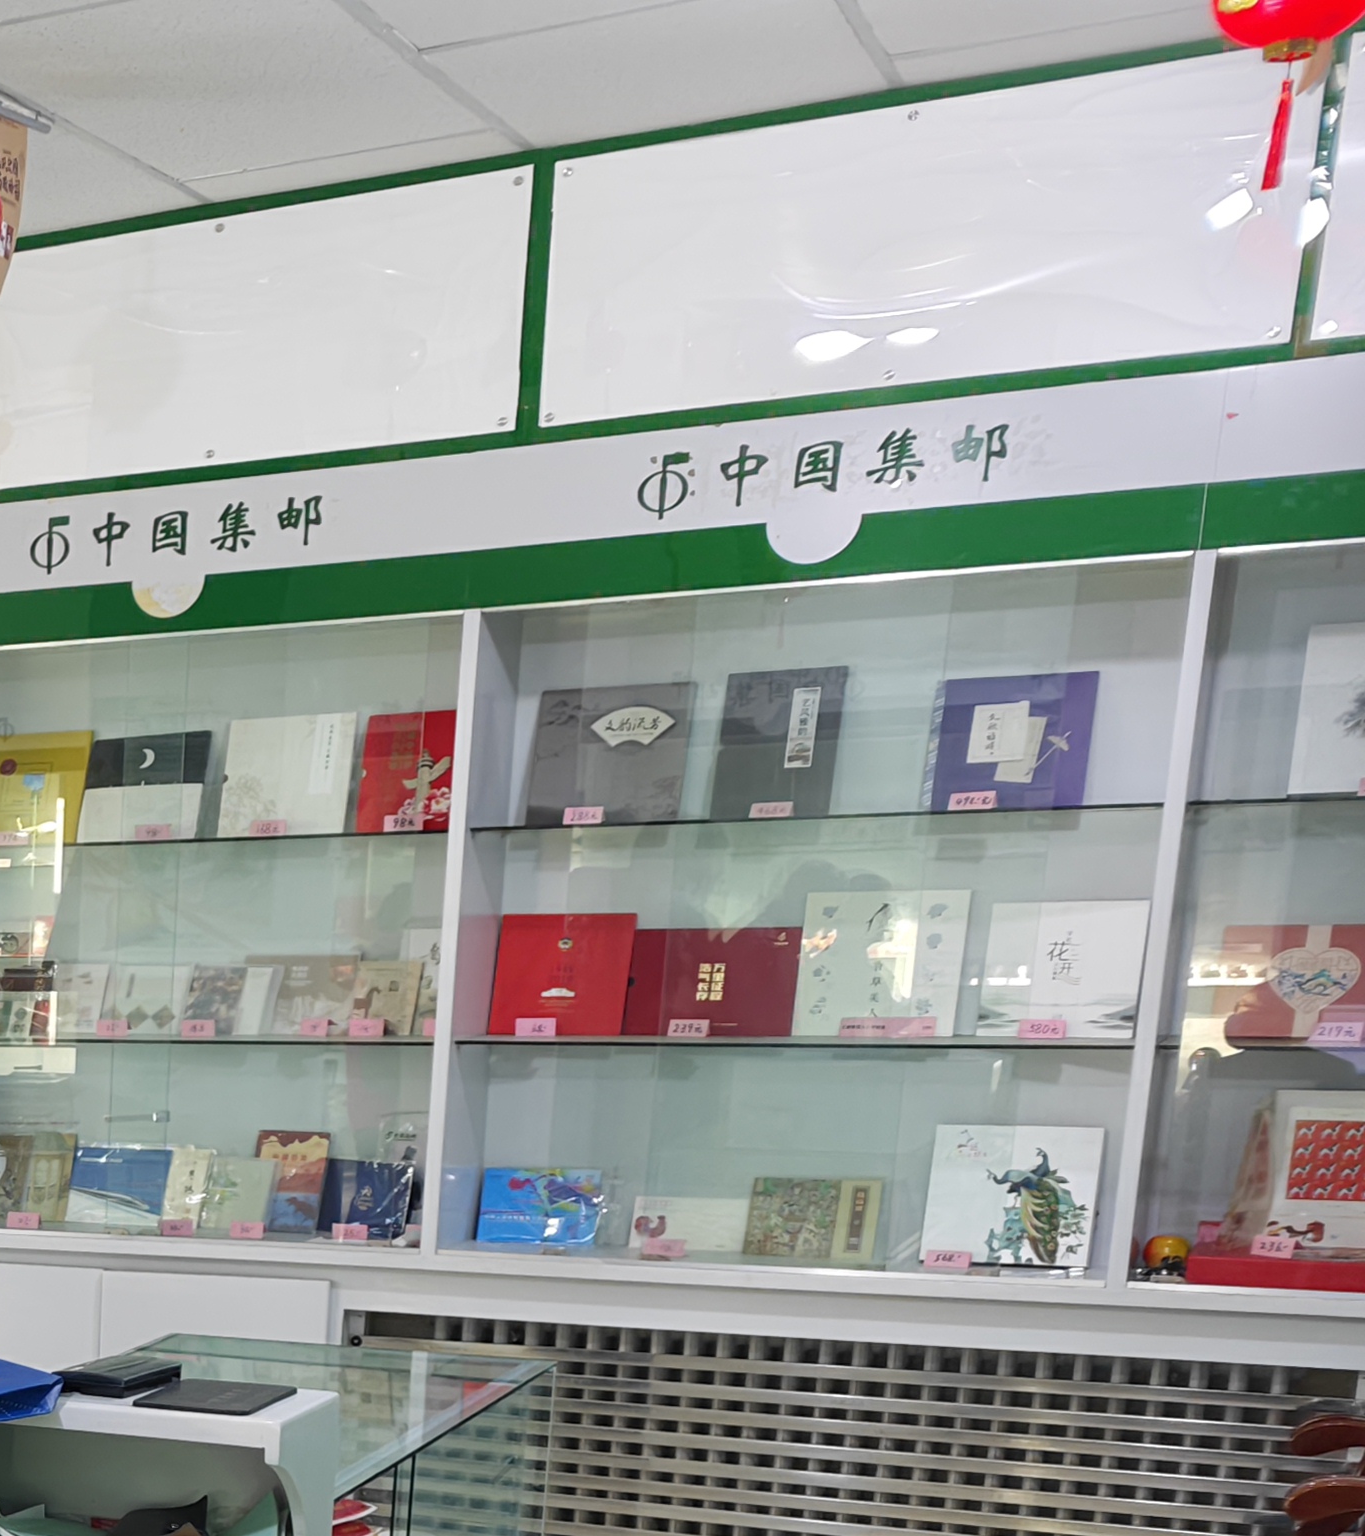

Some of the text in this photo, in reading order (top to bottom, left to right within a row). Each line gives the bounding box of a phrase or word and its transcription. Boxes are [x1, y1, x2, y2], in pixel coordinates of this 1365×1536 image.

[720, 423, 1010, 507] 中国集邮
[92, 495, 323, 567] 中国集邮
